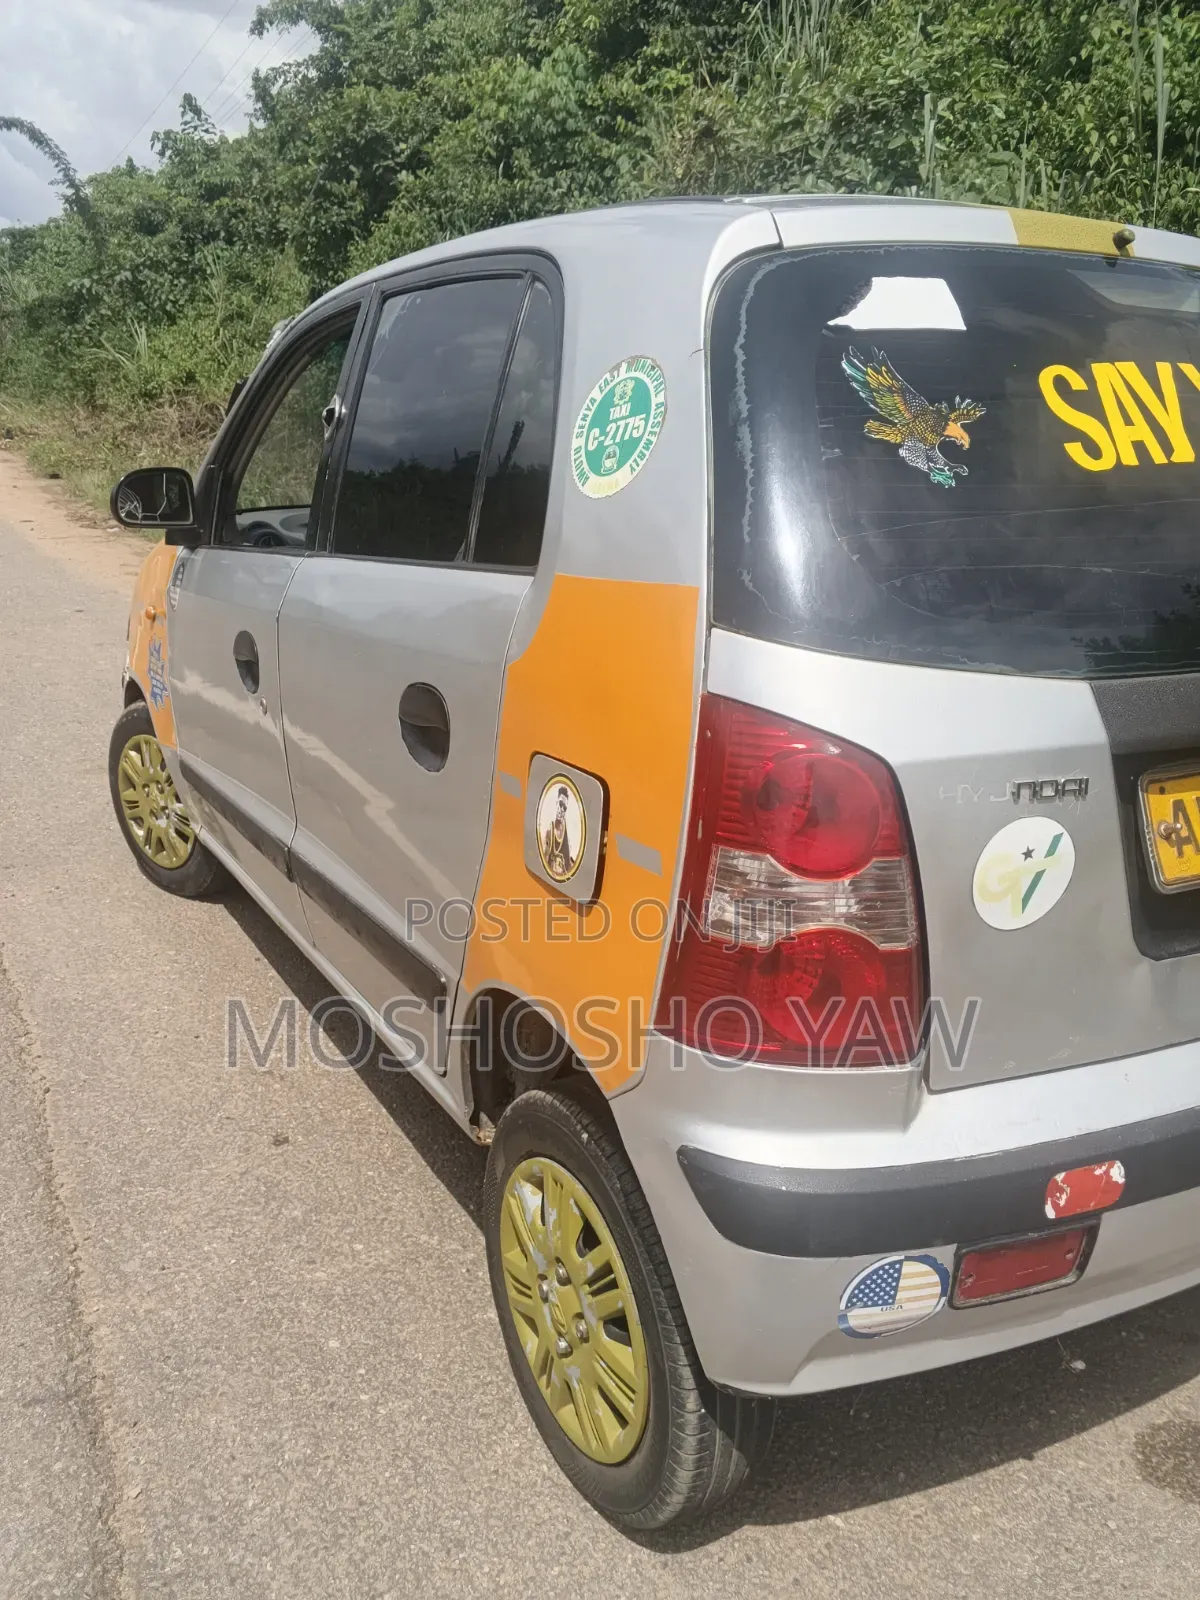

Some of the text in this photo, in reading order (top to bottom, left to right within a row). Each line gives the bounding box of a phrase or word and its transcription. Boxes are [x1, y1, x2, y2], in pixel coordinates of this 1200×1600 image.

[625, 358, 665, 398] MUNICIPAL
[576, 397, 597, 440] SENYA
[609, 402, 632, 421] TAXI
[1038, 361, 1196, 473] SAY
[587, 414, 647, 451] C-2775
[629, 401, 665, 475] ASSEMBLY
[573, 445, 590, 487] AWUTU
[880, 1304, 903, 1313] USA
